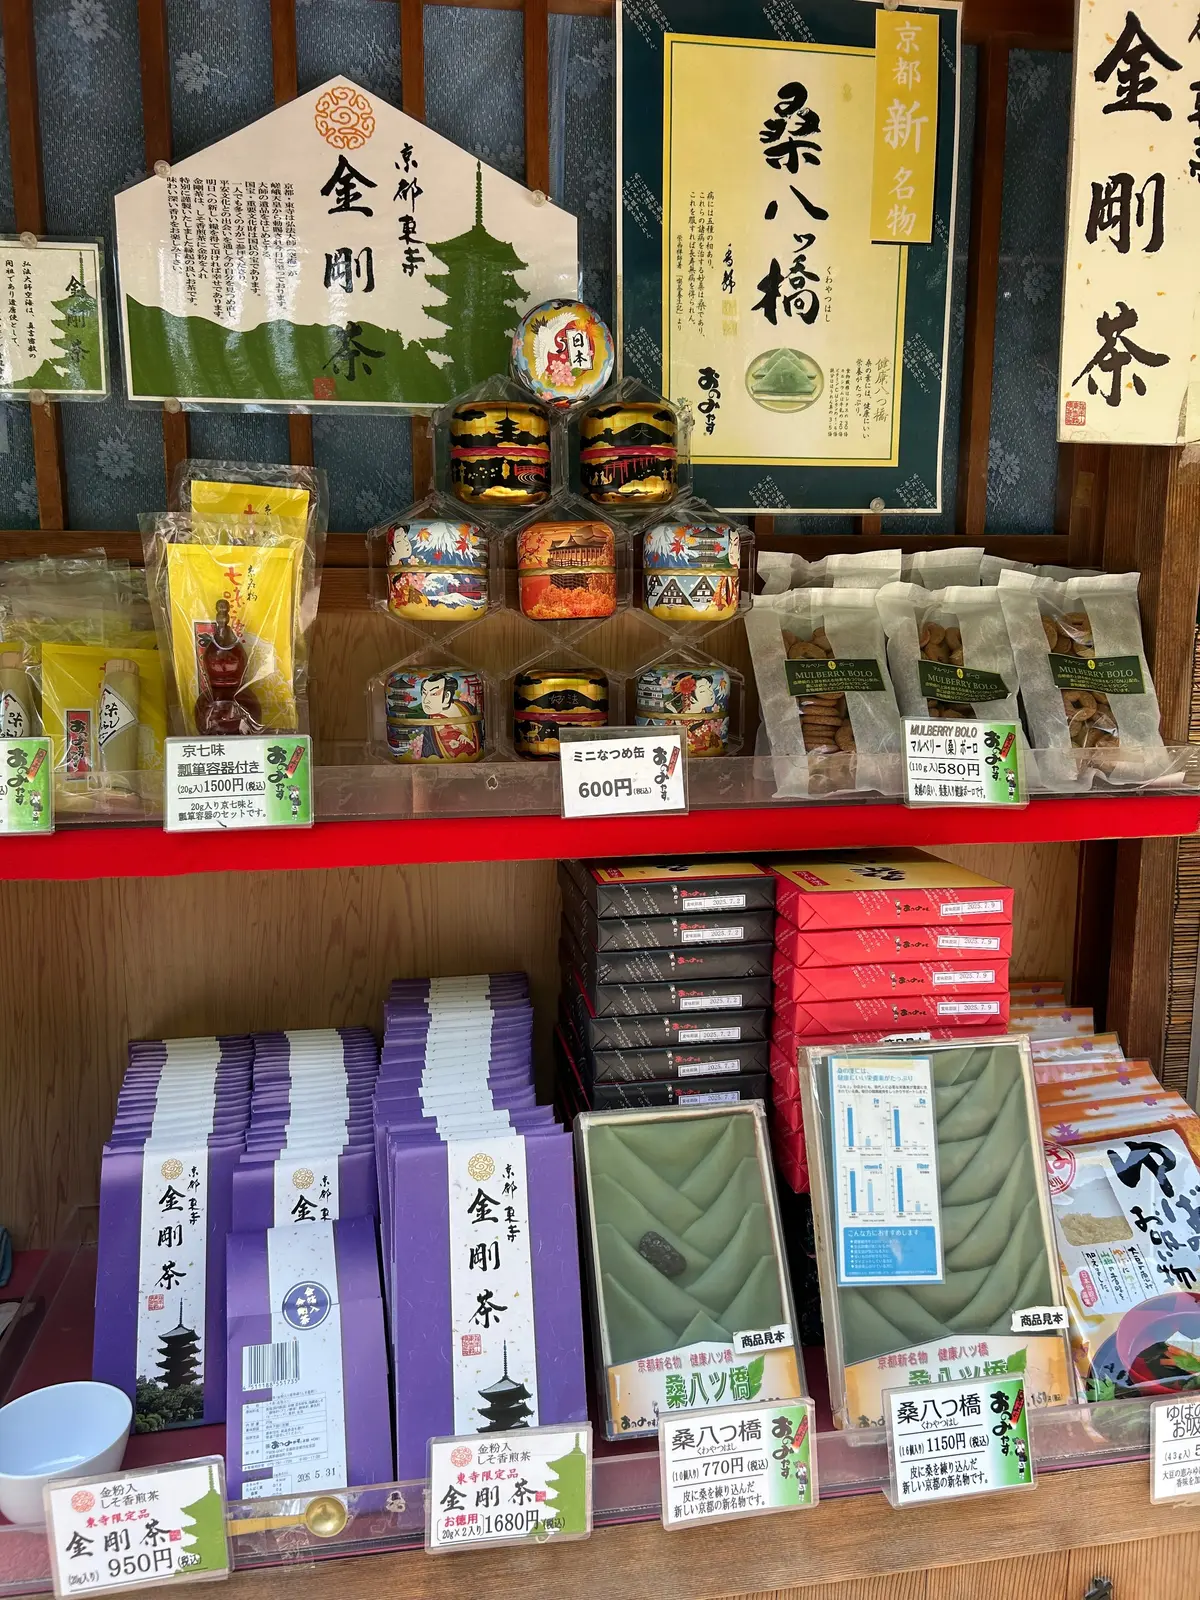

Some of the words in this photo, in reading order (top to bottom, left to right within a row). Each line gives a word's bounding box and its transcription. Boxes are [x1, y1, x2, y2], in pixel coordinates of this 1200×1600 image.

[882, 20, 929, 236] 京都新名物
[1072, 10, 1183, 407] 金剛茶
[320, 154, 386, 382] 金剛茶
[824, 266, 833, 322] くわやつはし
[65, 275, 90, 363] 金剛茶
[571, 331, 588, 367] 日本
[873, 356, 890, 422] 健康八つ橋
[795, 671, 846, 679] MULBERRY
[928, 673, 972, 689] MULBERRY
[973, 682, 998, 690] BOLO
[1059, 665, 1105, 678] MULBERRY
[1106, 669, 1134, 678] BOLO
[910, 724, 954, 737] MULBERRY
[955, 726, 978, 738] BOLO
[182, 743, 226, 758] 京七味
[573, 746, 645, 763] ミニなつめ缶
[911, 739, 941, 754] マルベリー
[960, 740, 978, 755] ボーロ
[938, 763, 980, 777] 580円
[204, 777, 244, 793] 1500円
[246, 781, 266, 792] (税込)
[578, 778, 632, 798] 600円
[190, 800, 254, 811] 20g入り京七味と
[501, 1164, 518, 1200] 京都
[154, 1184, 187, 1290] 金剛茶
[467, 1187, 509, 1329] 金剛茶
[1020, 1312, 1064, 1327] 商品見本
[740, 1331, 786, 1349] 商品見本
[637, 1355, 683, 1373] 京都新名物
[689, 1349, 735, 1368] 健康八ツ橋
[877, 1350, 929, 1370] 京都新名物
[937, 1342, 990, 1362] 健康八ツ橋
[665, 1365, 751, 1409] 桑八ツ橋
[896, 1392, 981, 1425] 桑八つ橋
[671, 1418, 762, 1451] 桑八つ橋
[920, 1417, 960, 1431] くわやつはし
[478, 1442, 512, 1455] 金粉入
[696, 1442, 738, 1456] くわやつはし
[926, 1432, 967, 1453] 1150円
[969, 1434, 990, 1448] (税込)
[477, 1451, 532, 1465] しそ香煎茶
[702, 1456, 744, 1477] 770円
[747, 1458, 769, 1472] (税込)
[455, 1468, 519, 1486] 東寺限定品
[910, 1458, 978, 1480] 皮に桑を練り込んだ
[100, 1483, 138, 1499] 金粉入
[682, 1480, 756, 1504] 皮に桑を練り込んだ
[902, 1470, 988, 1495] 新しい京都の新名物です。
[101, 1490, 161, 1509] しそ香煎茶
[439, 1477, 538, 1513] 金剛茶
[674, 1494, 766, 1519] 新しい京都の新名物です。
[85, 1508, 150, 1529] 東寺限定品
[444, 1513, 479, 1527] お徳用
[484, 1509, 540, 1535] 1680円
[542, 1517, 566, 1529] (税込)
[65, 1518, 171, 1560] 金剛茶
[107, 1547, 174, 1578] 950円
[177, 1553, 202, 1569] (税込)
